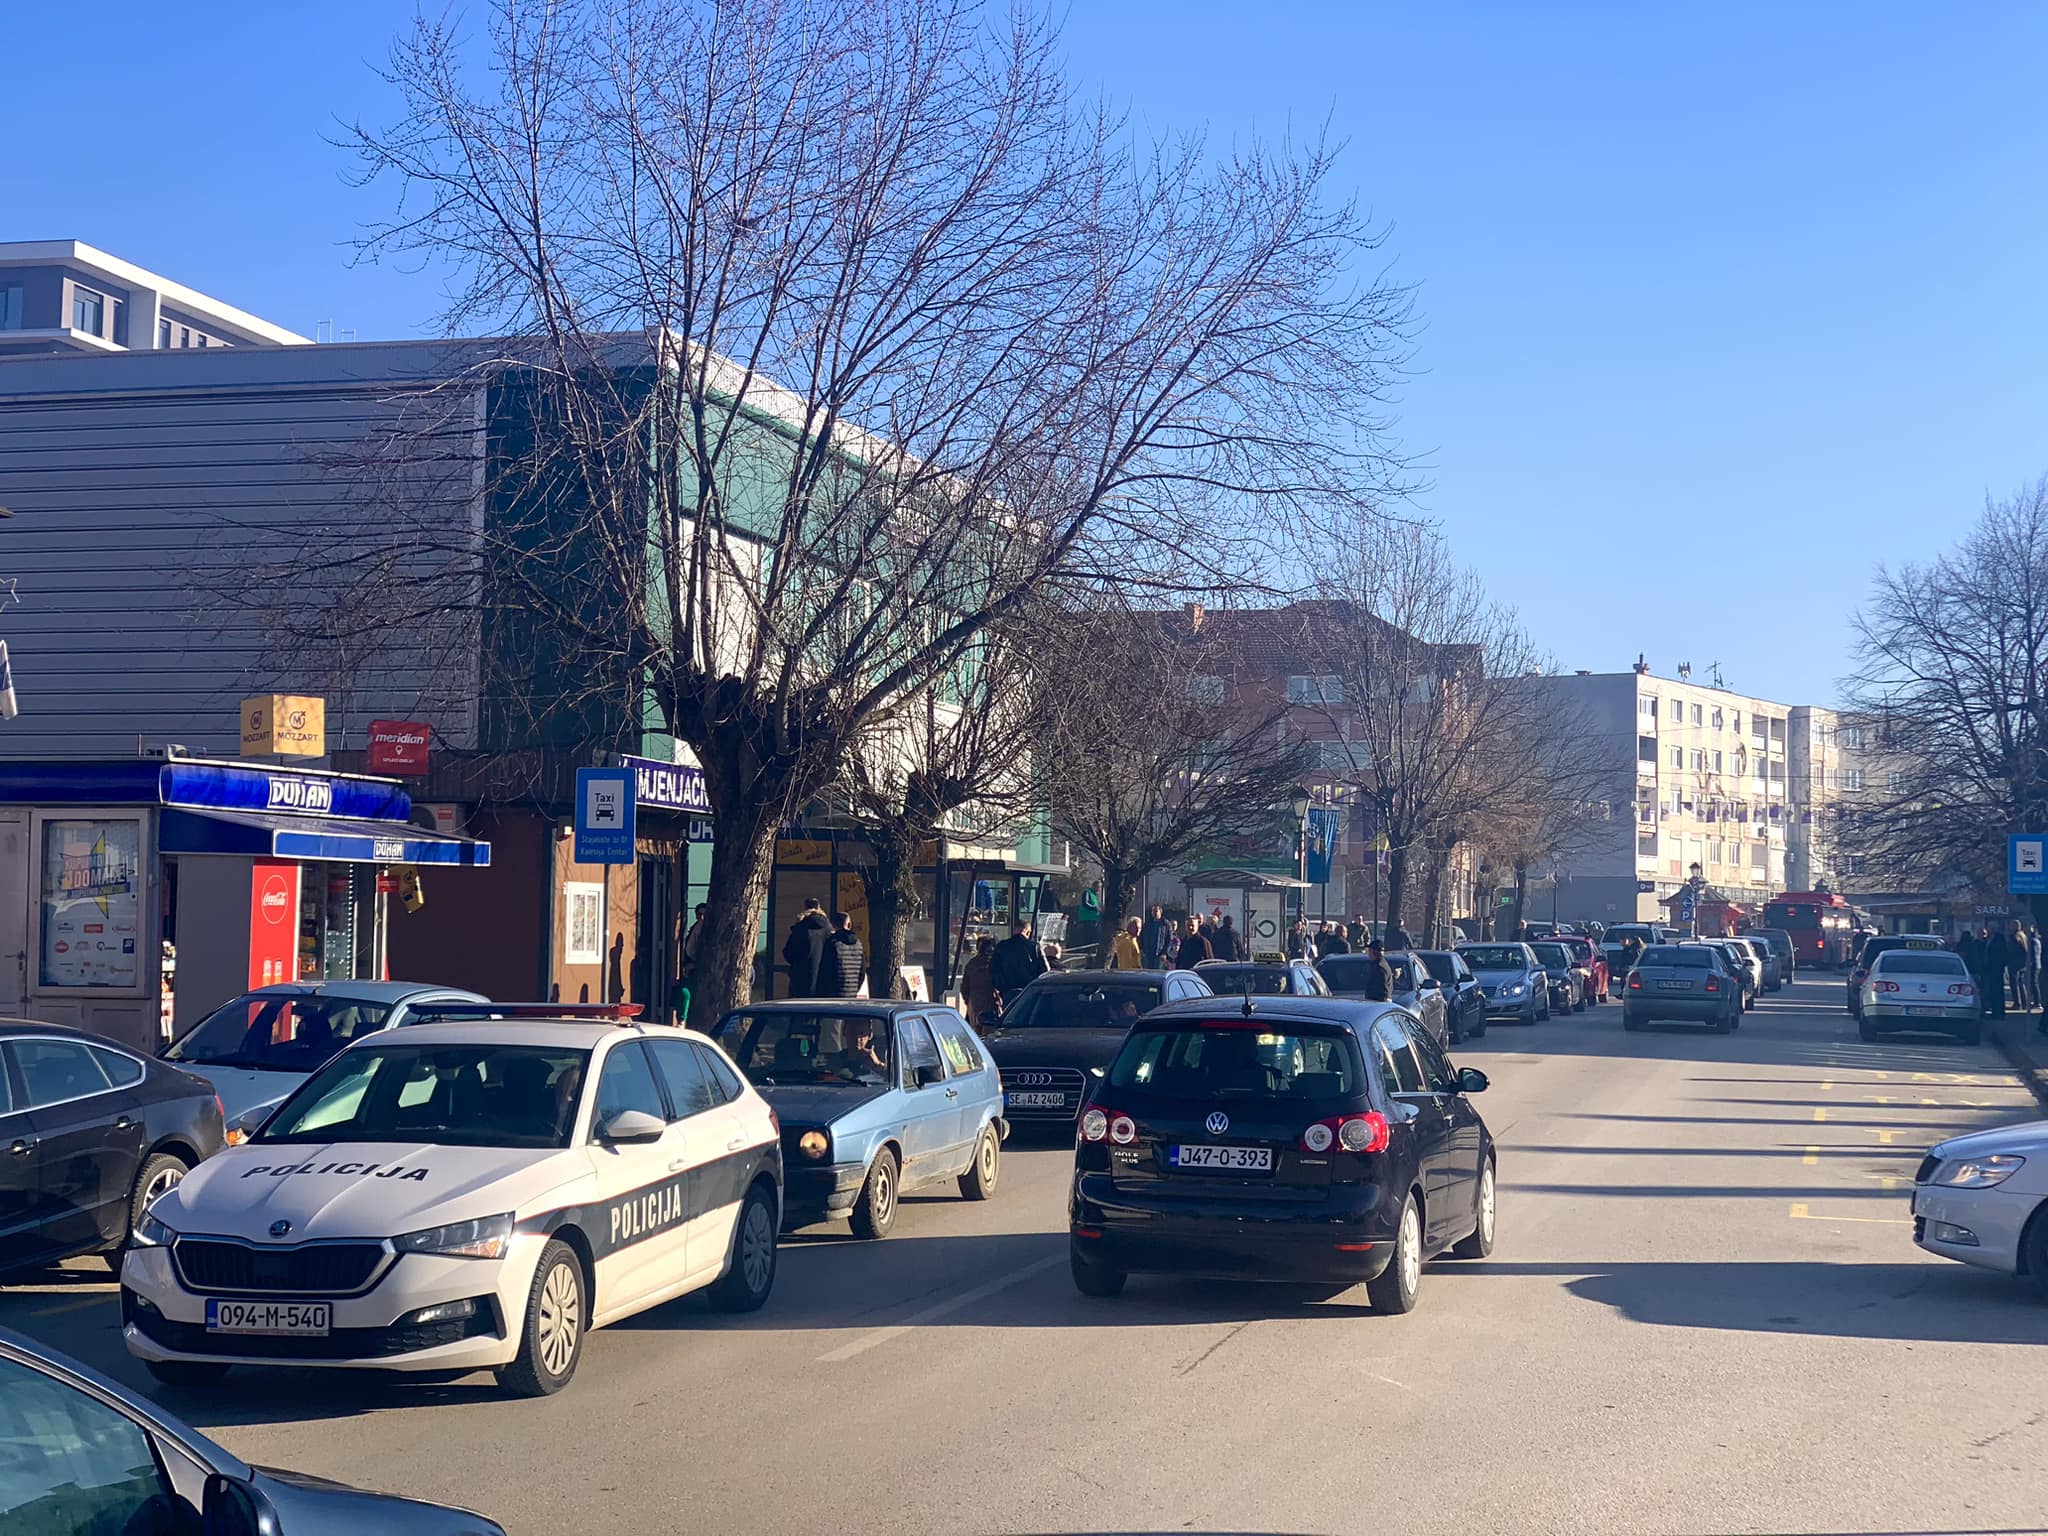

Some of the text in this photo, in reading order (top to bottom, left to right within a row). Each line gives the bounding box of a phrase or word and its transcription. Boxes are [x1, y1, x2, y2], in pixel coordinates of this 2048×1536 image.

[277, 732, 319, 742] MOZZART
[375, 732, 424, 745] meridian
[271, 781, 329, 808] DUHAN
[638, 767, 713, 808] MJENJAČN
[595, 792, 615, 803] Taxi
[375, 842, 402, 857] DUHAN
[1009, 1094, 1021, 1105] SE
[1041, 1094, 1064, 1105] 2406
[240, 1162, 430, 1182] POLICIJA
[611, 1183, 681, 1244] POLICIJA
[219, 1305, 326, 1328] 094-M-540
